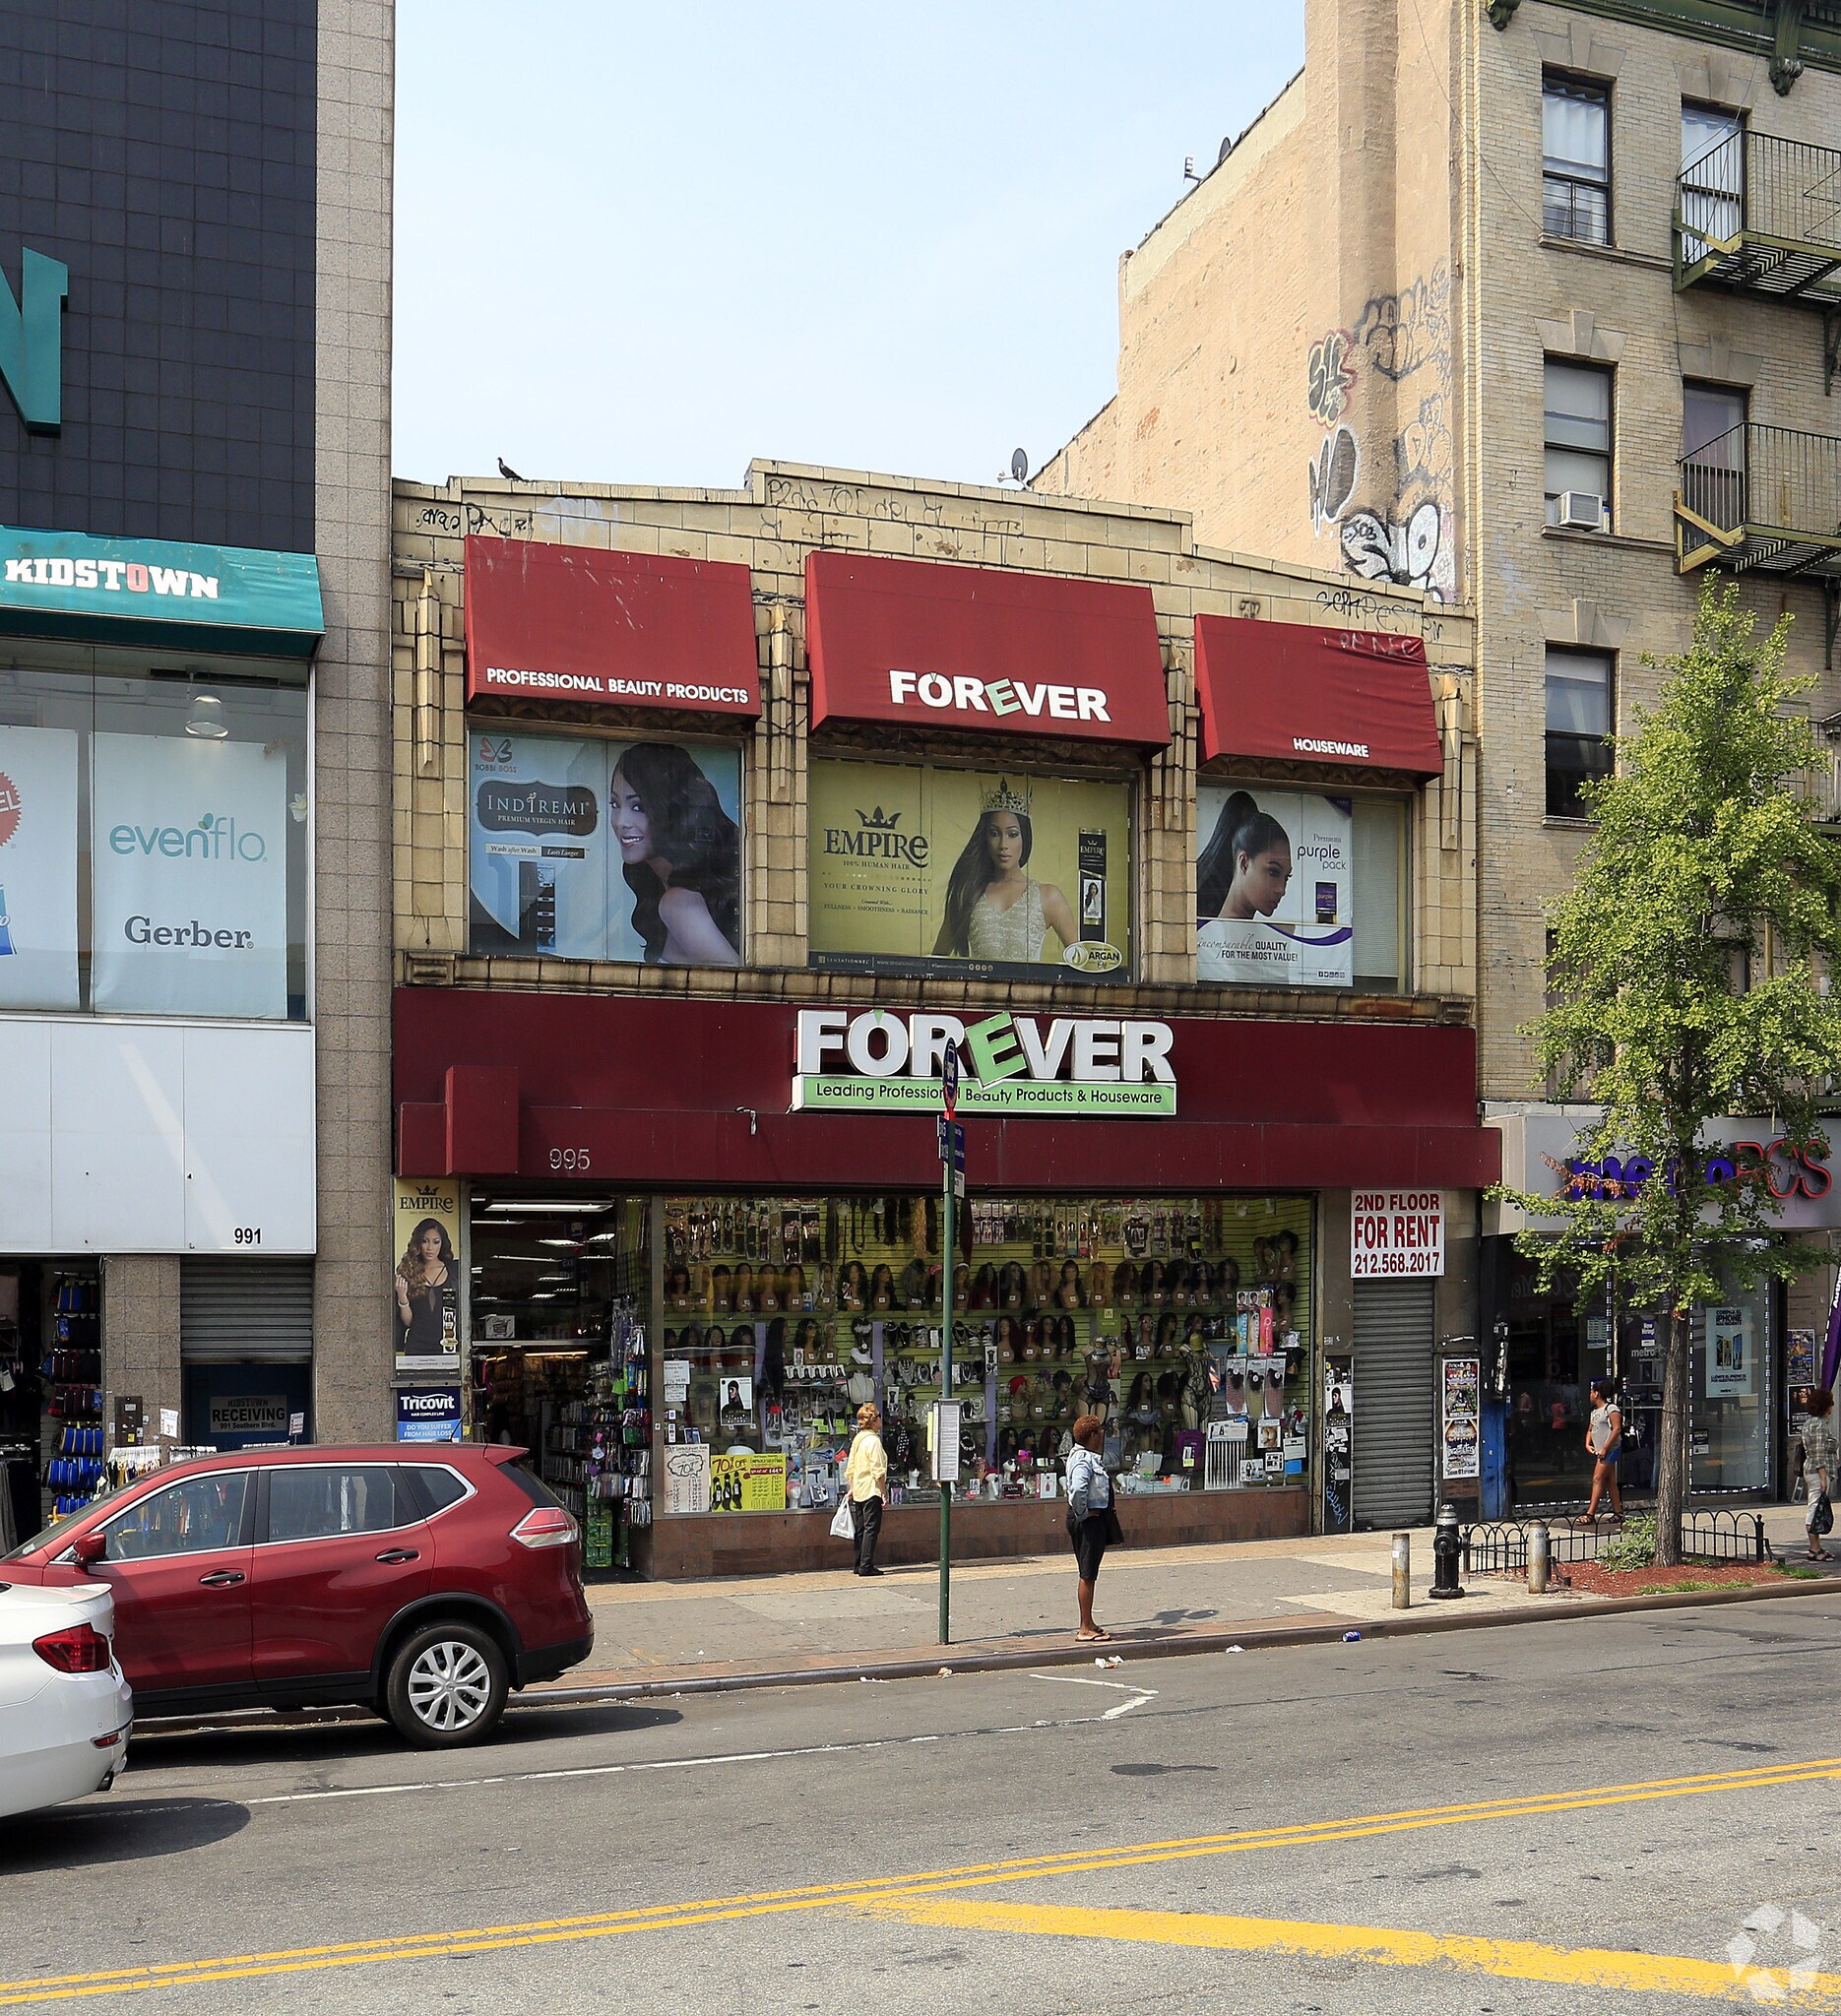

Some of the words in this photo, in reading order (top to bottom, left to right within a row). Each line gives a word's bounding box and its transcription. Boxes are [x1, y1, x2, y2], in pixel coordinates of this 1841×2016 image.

[4, 557, 220, 599] KIDSTOWN
[486, 667, 603, 693] PROFESSIONAL
[607, 677, 663, 698] BEAUTY
[667, 683, 749, 704] PRODUCTS
[889, 669, 1112, 723] FOREVER
[1293, 737, 1369, 758] HOUSEWARE
[497, 814, 531, 823] PREMIUM
[109, 814, 267, 863] evenflo
[1298, 844, 1341, 862] purple
[861, 860, 889, 869] HUMAN
[1322, 859, 1347, 871] pack
[851, 884, 897, 893] CROWNING
[124, 914, 253, 949] Gerber
[1255, 941, 1288, 951] QUALITY
[1088, 951, 1120, 962] ARGAN
[1221, 950, 1236, 960] FOR
[1237, 951, 1250, 960] THE
[1251, 951, 1272, 961] MOST
[1272, 952, 1298, 962] VALUE!
[796, 1009, 1176, 1087] FOREVER
[816, 1084, 874, 1101] Leading
[879, 1084, 961, 1100] Professionl
[966, 1089, 1012, 1104] Beauty
[1016, 1089, 1074, 1102] Products
[1077, 1092, 1087, 1102] &
[1091, 1091, 1163, 1104] Houseware
[548, 1148, 591, 1170] 995
[1355, 1194, 1384, 1212] 2ND
[1390, 1193, 1439, 1211] FLOOR
[234, 1227, 262, 1245] 991
[1354, 1216, 1388, 1249] FOR
[1394, 1215, 1440, 1248] RENT
[1354, 1252, 1440, 1274] 212.568.2017
[400, 1394, 455, 1410] Tricovit
[212, 1408, 286, 1422] RECEIVING
